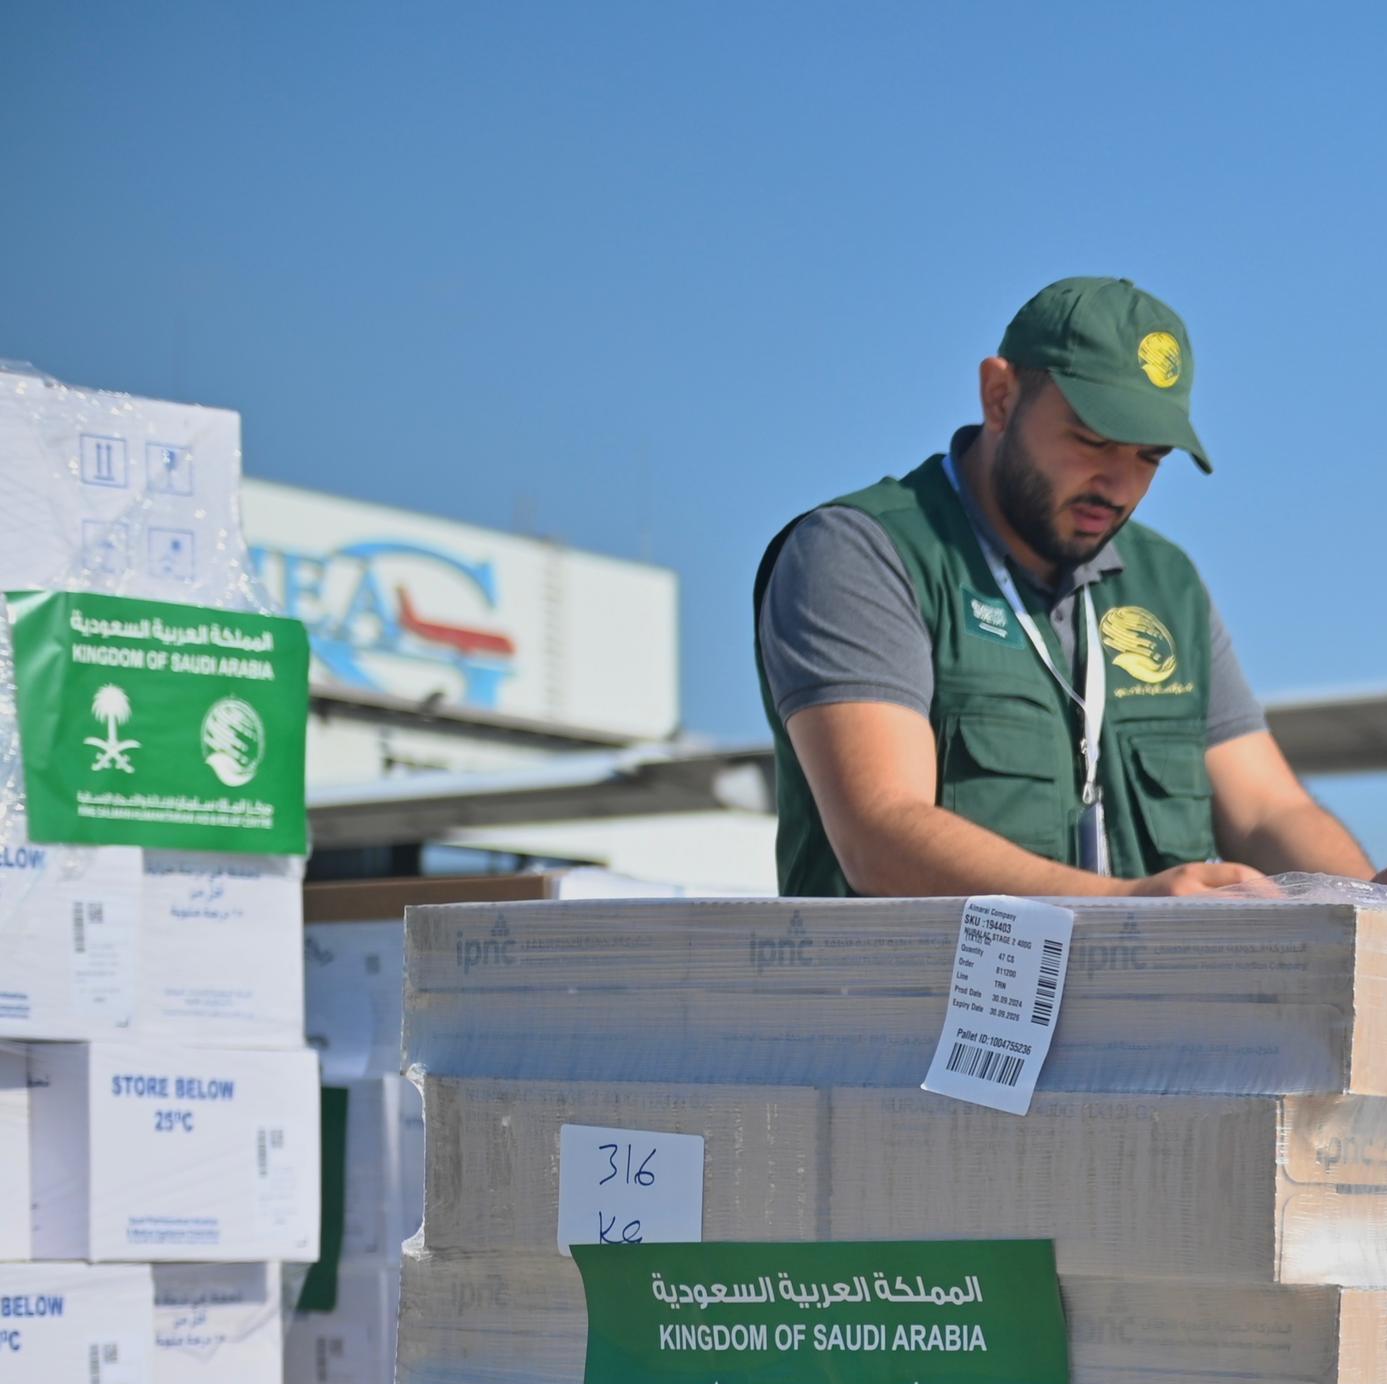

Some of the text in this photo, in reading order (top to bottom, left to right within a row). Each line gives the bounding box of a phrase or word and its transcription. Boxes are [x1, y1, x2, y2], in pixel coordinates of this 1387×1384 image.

[70, 609, 274, 652] المملكة العربية السعودية
[72, 643, 275, 681] KINGDOM OF SAUDI ARABIA
[964, 914, 981, 927] SKU
[991, 908, 1017, 922] Company
[456, 931, 517, 975] ipnc
[749, 931, 814, 975] ipnc
[961, 944, 984, 957] Quantity
[959, 957, 975, 968] Order
[957, 971, 968, 980] Line
[969, 987, 982, 998] Date
[952, 998, 984, 1013] Expiry Date
[957, 1028, 978, 1041] Pallet
[112, 1075, 234, 1100] STORE BELOW
[598, 1144, 656, 1187] 316
[652, 1272, 983, 1309] المملكة العربية السعودية
[1, 1296, 64, 1318] BELOW
[659, 1324, 988, 1351] KINGDOM OF SAUDI ARABIA
